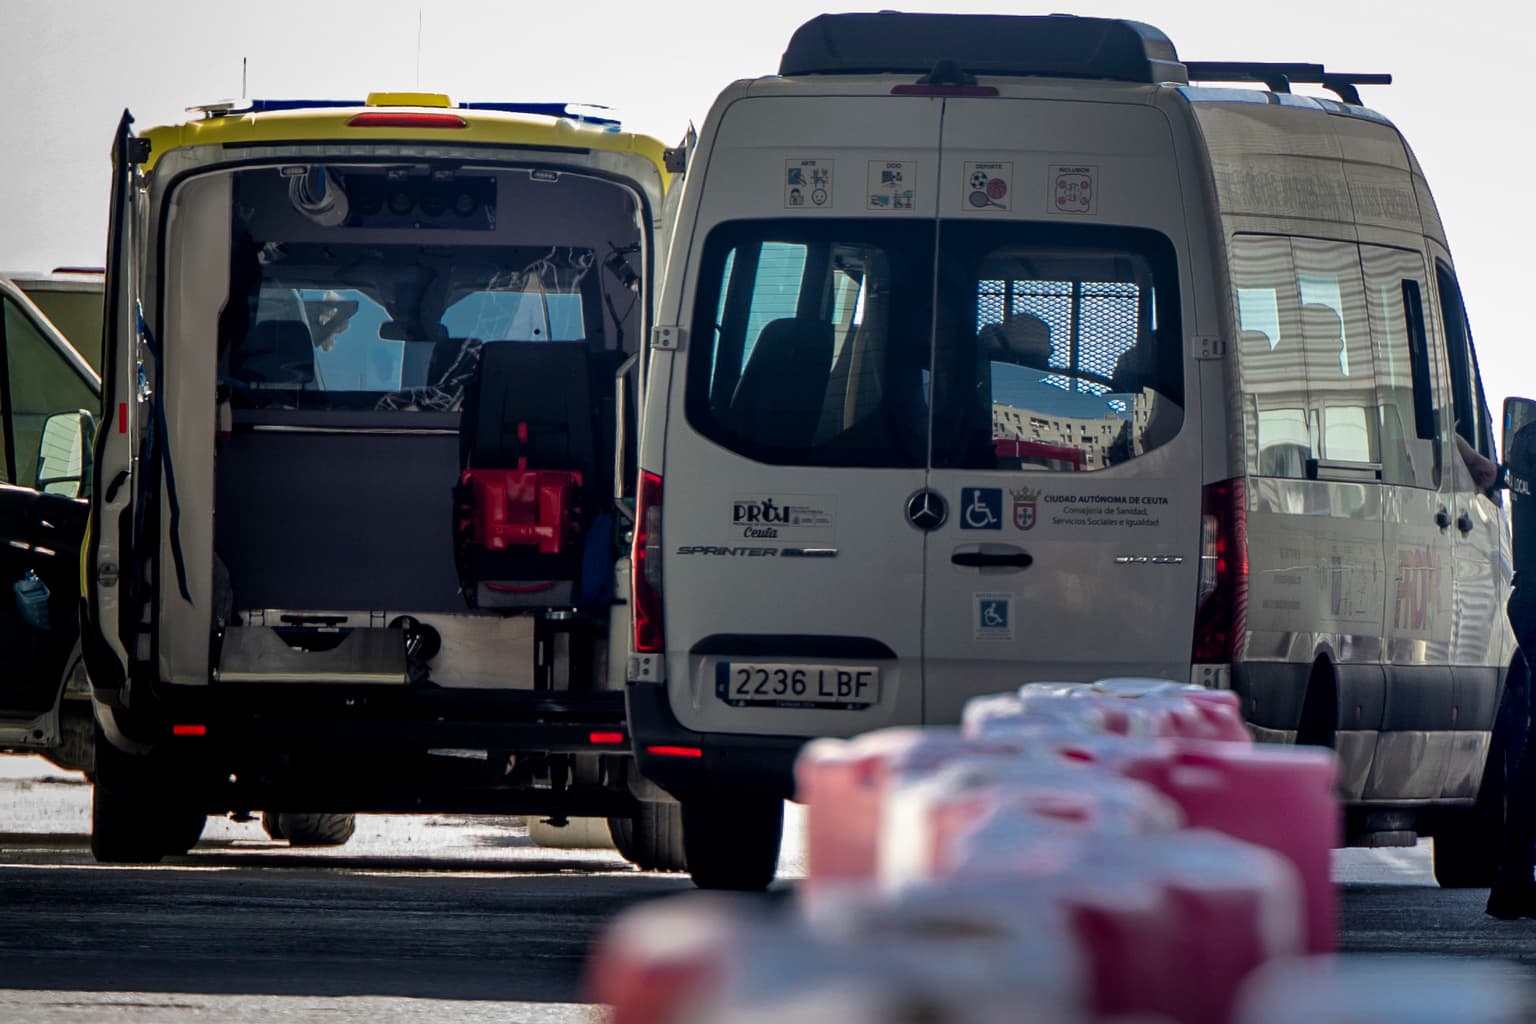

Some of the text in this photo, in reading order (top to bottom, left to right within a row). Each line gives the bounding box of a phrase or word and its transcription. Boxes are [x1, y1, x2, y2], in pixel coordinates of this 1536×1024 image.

[1044, 494, 1169, 505] CIUDAD AUTÓNOMA DE CEUTA
[1104, 507, 1115, 515] de
[1052, 516, 1086, 525] Servicios
[1088, 517, 1118, 526] Sociales
[1126, 517, 1160, 527] Igualdad
[743, 526, 778, 538] Ceuta
[676, 546, 779, 557] SPRINTER
[736, 669, 872, 698] 2236 LBF
